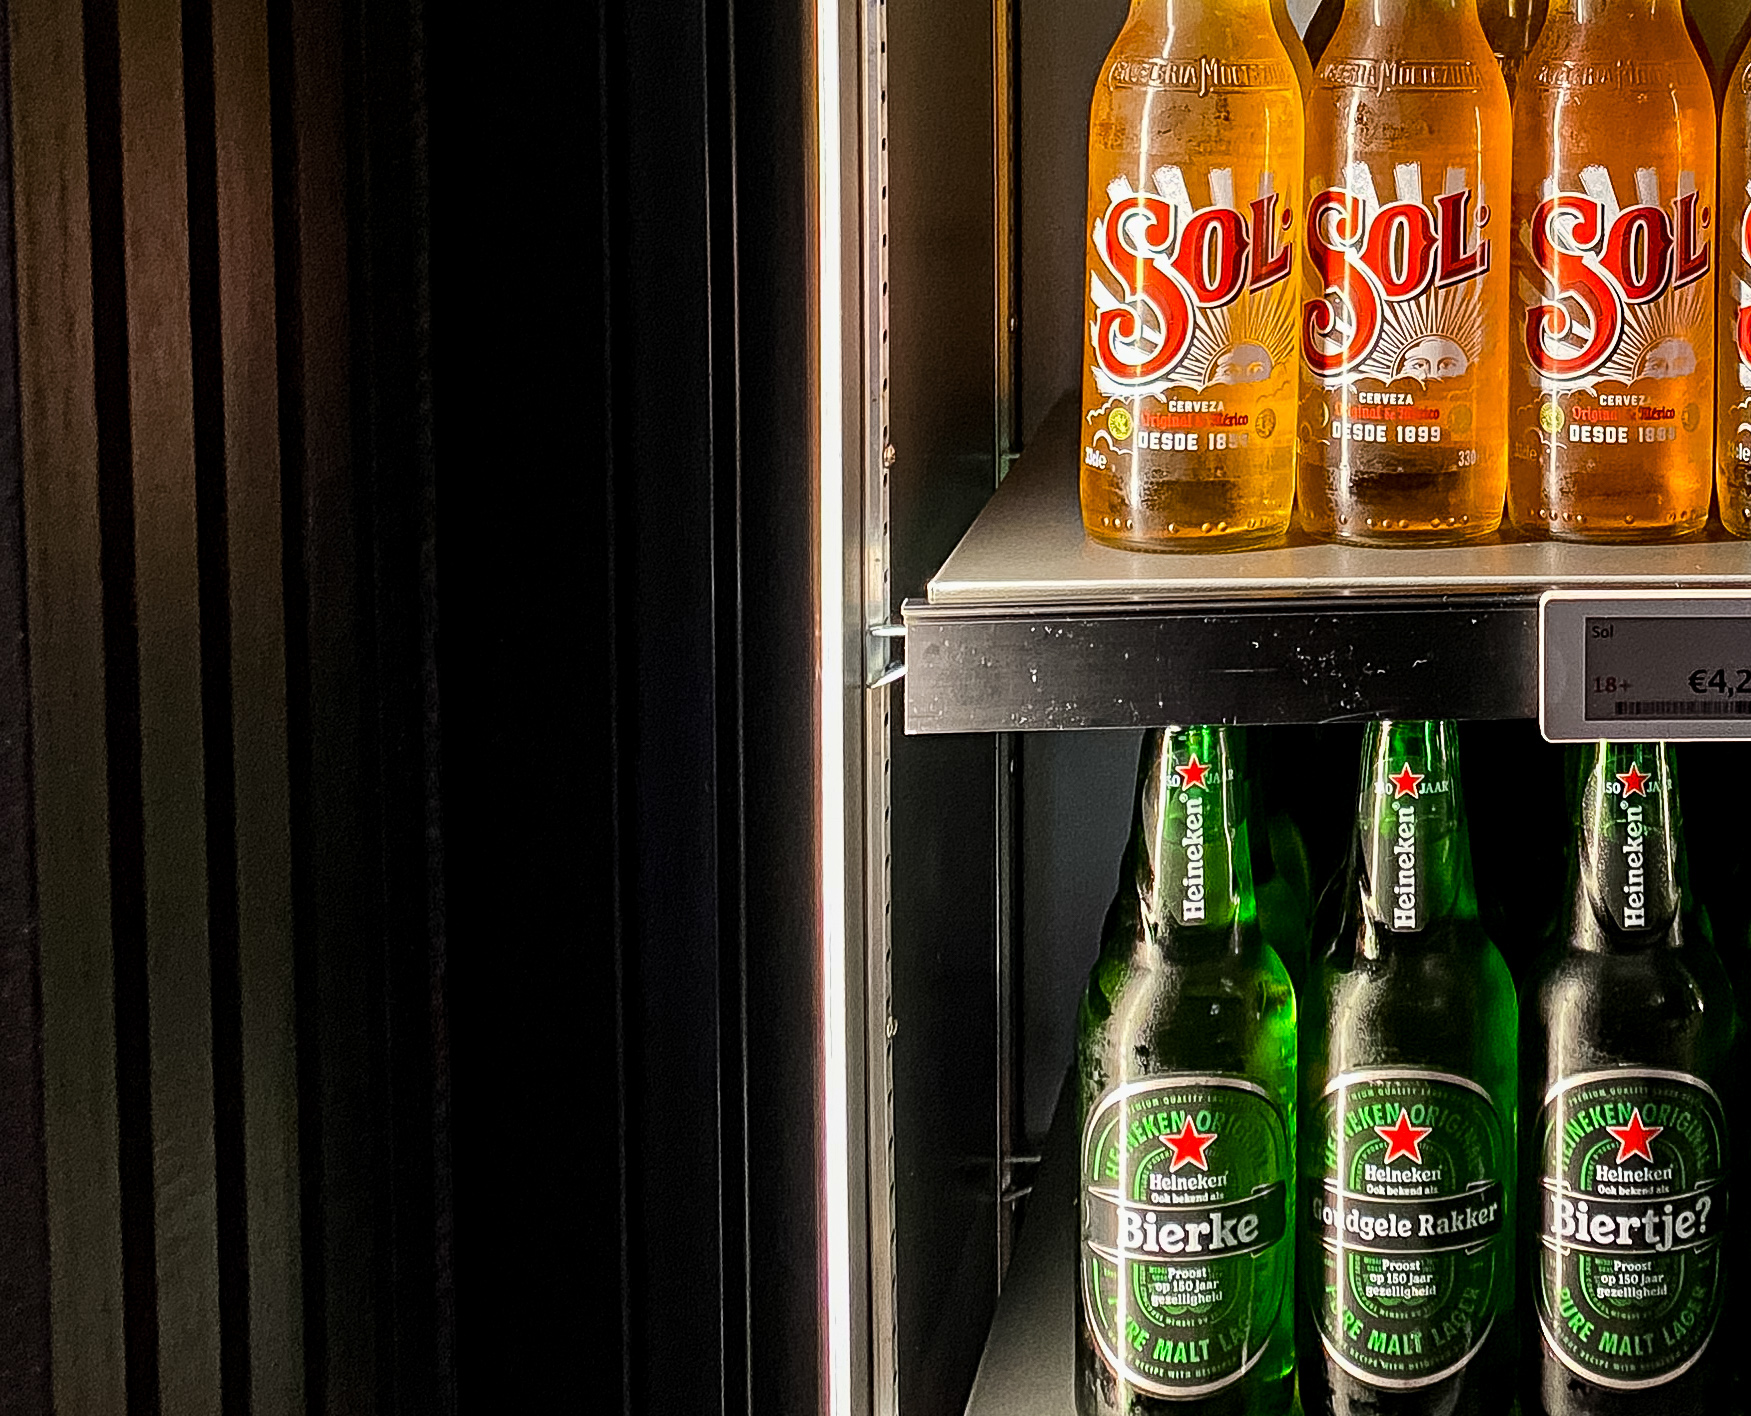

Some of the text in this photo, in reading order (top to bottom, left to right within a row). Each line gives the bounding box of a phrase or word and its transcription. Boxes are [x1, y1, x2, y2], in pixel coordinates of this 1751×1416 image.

[1098, 192, 1293, 384] SOL
[1304, 187, 1491, 379] SOL
[1526, 190, 1712, 380] SOL
[1168, 399, 1225, 413] CERVEZA
[1358, 393, 1413, 405] CERVEZA
[1138, 432, 1198, 450] DESDE
[1332, 425, 1442, 443] DESDE 1899
[1569, 425, 1628, 444] DESDE
[1592, 625, 1614, 639] Sol
[1593, 676, 1632, 693] 18+
[1183, 797, 1204, 921] Heineken
[1394, 805, 1416, 929] Heineken
[1623, 804, 1645, 928] Heineken
[1150, 1171, 1228, 1191] Heineken
[1365, 1164, 1442, 1183] Heineken
[1596, 1164, 1673, 1182] Heineken
[1418, 1202, 1498, 1237] Rakker
[1550, 1195, 1712, 1252] Biertje?
[1117, 1212, 1259, 1253] Bierke
[1613, 1260, 1652, 1272] Proost
[1601, 1273, 1664, 1287] op 150 jaar
[1596, 1285, 1668, 1299] gezelligheid
[1560, 1288, 1595, 1343] PURE
